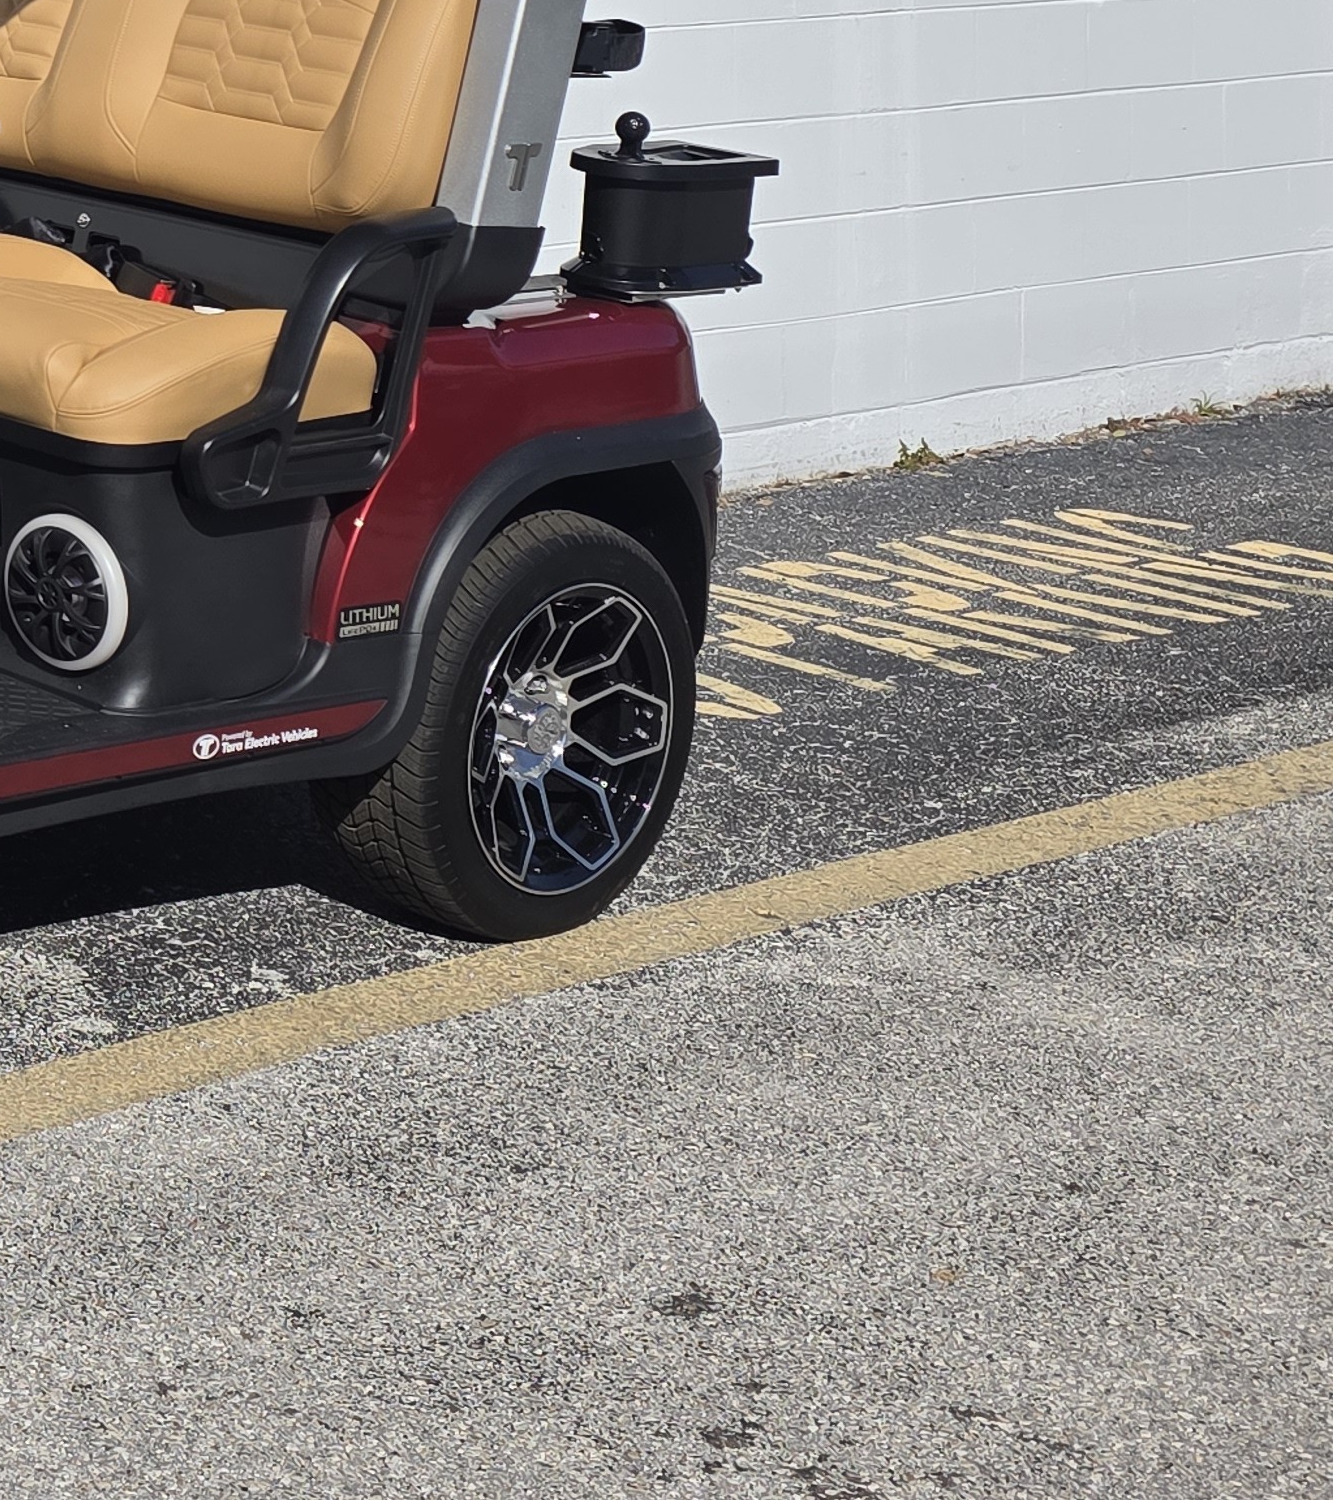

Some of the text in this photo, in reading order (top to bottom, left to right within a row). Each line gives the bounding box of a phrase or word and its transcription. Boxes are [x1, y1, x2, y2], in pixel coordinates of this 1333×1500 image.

[340, 603, 400, 625] LITHIUM
[221, 727, 318, 754] Tara Electric Vehicles
